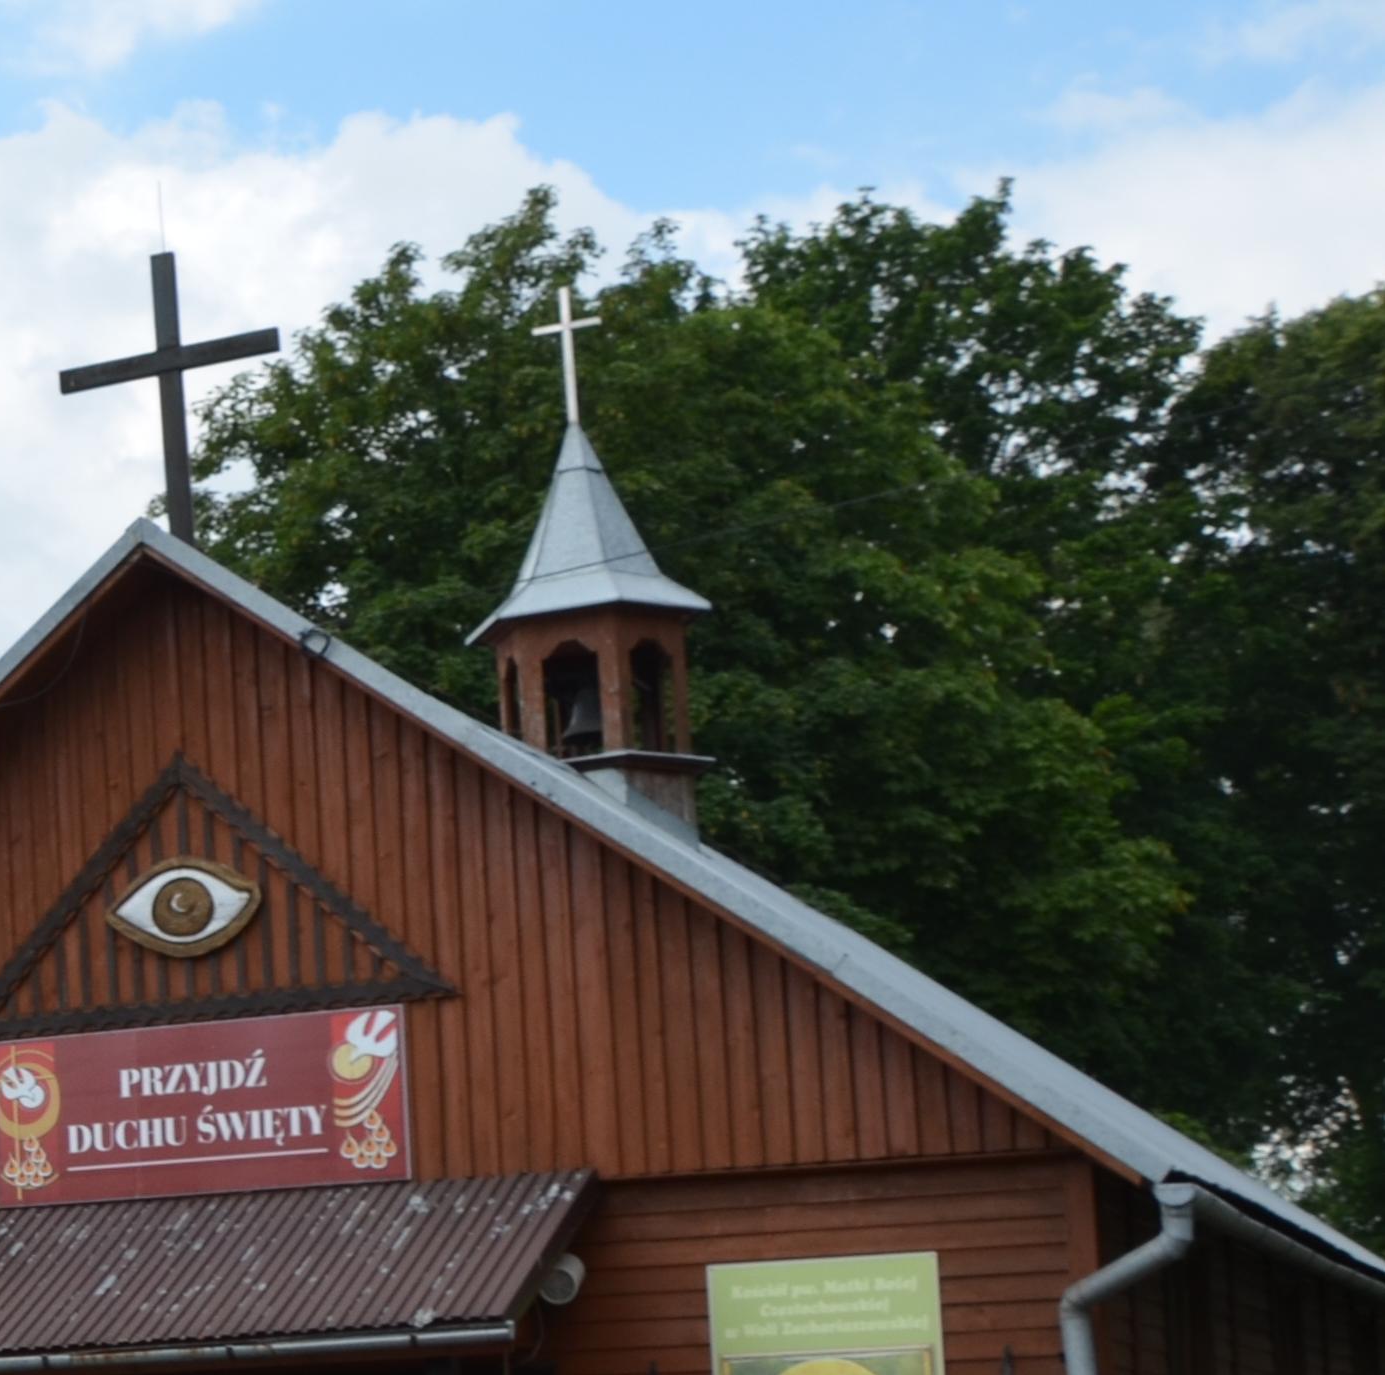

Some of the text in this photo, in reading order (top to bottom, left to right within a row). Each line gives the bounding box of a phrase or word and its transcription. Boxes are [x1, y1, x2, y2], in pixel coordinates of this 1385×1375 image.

[119, 1049, 267, 1098] PRZYJDŹ
[67, 1104, 327, 1154] DUCHU ŚWIĘTY
